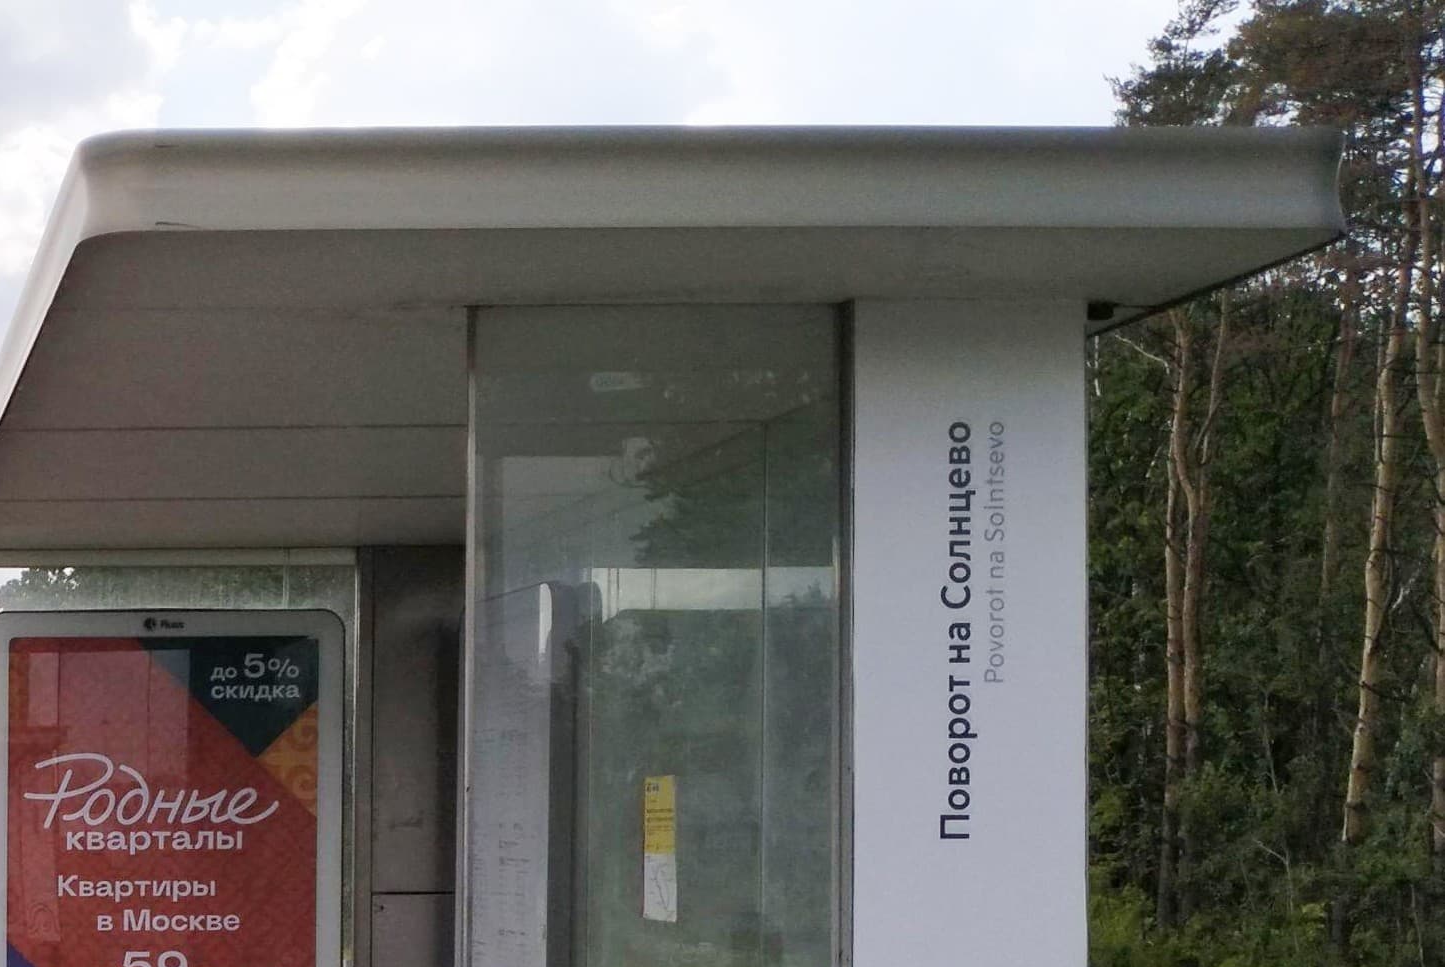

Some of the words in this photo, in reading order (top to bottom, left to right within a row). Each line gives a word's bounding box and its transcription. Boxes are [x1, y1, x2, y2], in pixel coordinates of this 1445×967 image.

[984, 421, 1005, 542] Solntsevo
[940, 421, 976, 610] Солнцево
[989, 551, 1005, 580] na
[948, 621, 971, 664] на
[984, 588, 1005, 683] Povorot
[210, 665, 237, 682] до
[243, 653, 300, 679] 5%
[210, 685, 301, 701] скидка
[939, 675, 978, 840] Поворот
[23, 752, 280, 830] Родные
[66, 831, 244, 856] кварталы
[57, 875, 216, 903] Квартиры
[97, 914, 114, 931] в
[122, 909, 241, 932] Москве
